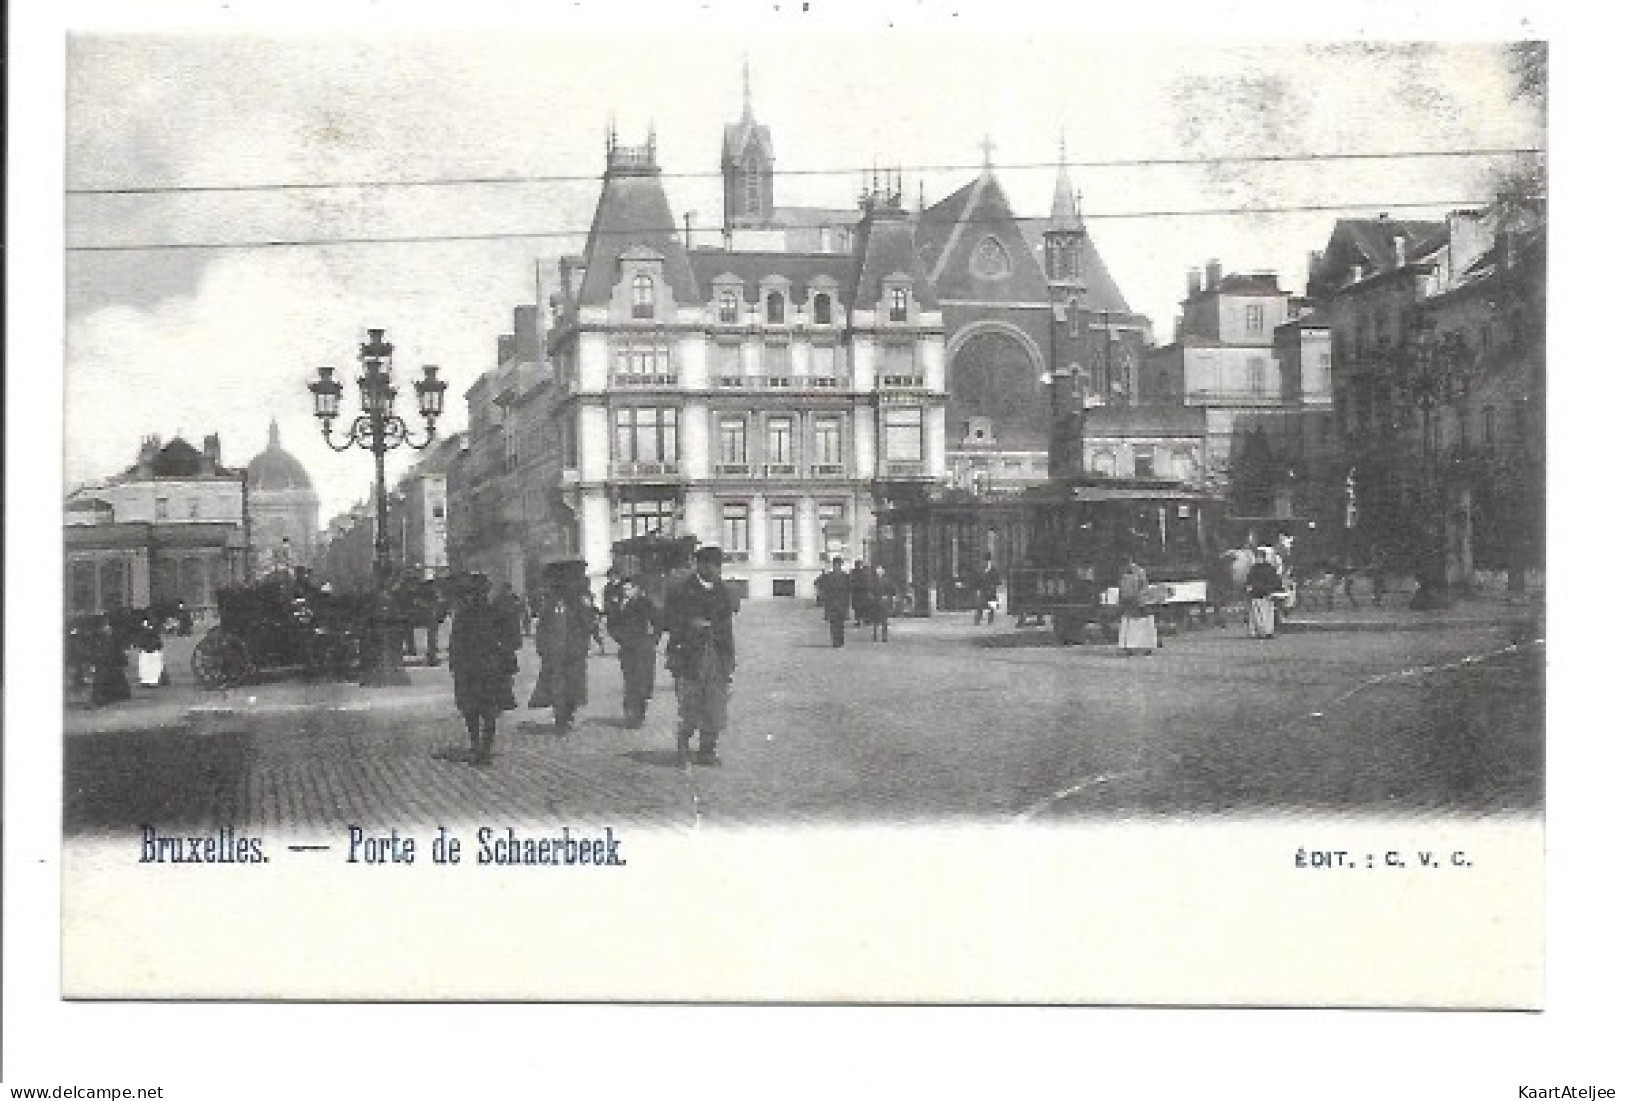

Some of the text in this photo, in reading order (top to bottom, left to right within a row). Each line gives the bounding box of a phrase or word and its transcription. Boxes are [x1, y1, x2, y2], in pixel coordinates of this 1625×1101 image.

[139, 825, 270, 864] Bruxelles.
[346, 825, 415, 865] Porte
[432, 826, 461, 865] de
[476, 826, 627, 866] Schaerbeek.
[1418, 851, 1438, 869] V.
